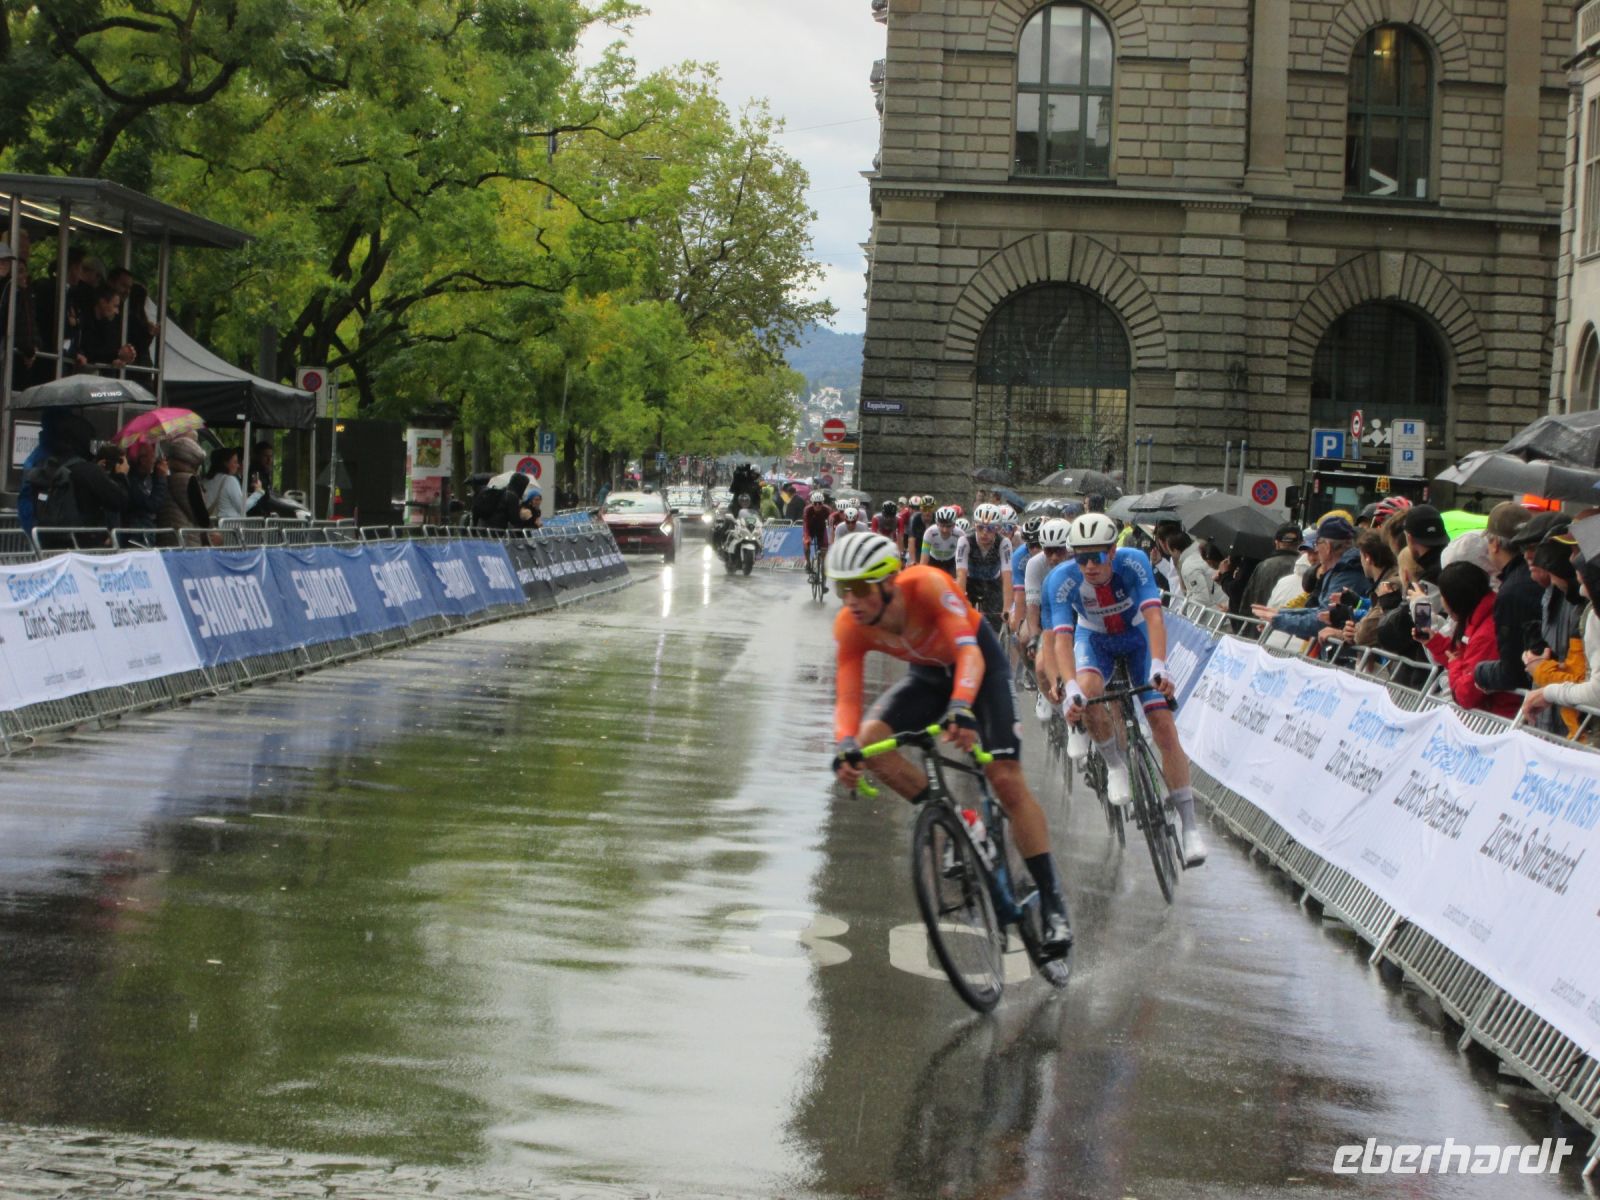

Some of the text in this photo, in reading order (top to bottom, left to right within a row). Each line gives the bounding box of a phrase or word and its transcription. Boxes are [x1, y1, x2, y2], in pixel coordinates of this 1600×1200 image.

[1322, 436, 1337, 458] P
[183, 575, 272, 638] SHIMANO
[291, 567, 357, 620] SHIMANO
[1480, 812, 1586, 895] Zürich, Switzerland.
